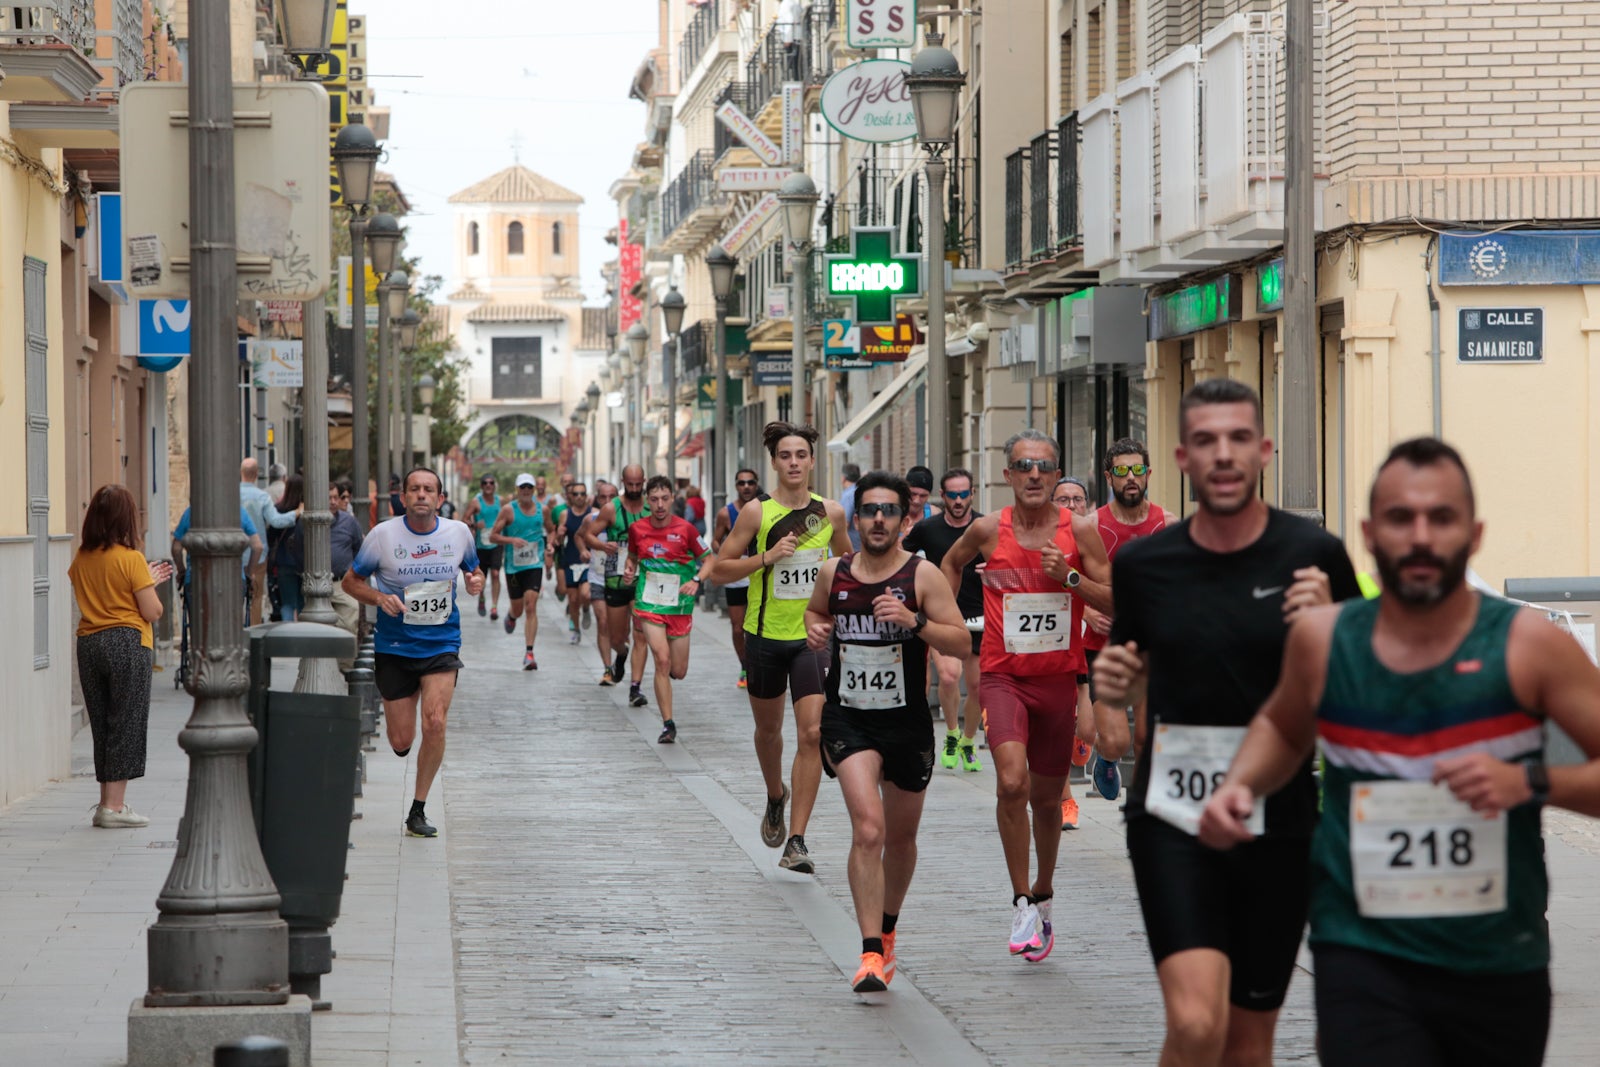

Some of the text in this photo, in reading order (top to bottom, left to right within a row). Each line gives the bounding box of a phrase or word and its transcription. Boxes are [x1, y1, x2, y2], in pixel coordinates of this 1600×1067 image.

[863, 111, 914, 126] Desde 1.8
[722, 106, 778, 164] ESTUDIO
[1486, 312, 1534, 326] CALLE
[1467, 341, 1534, 358] SAMANIEGO
[397, 565, 454, 576] MARACENA
[780, 567, 819, 585] 3118
[657, 583, 664, 595] 1
[410, 597, 448, 612] 3134
[1019, 614, 1057, 632] 275
[846, 670, 898, 690] 3142
[1166, 769, 1227, 802] 308
[1387, 828, 1473, 868] 218
